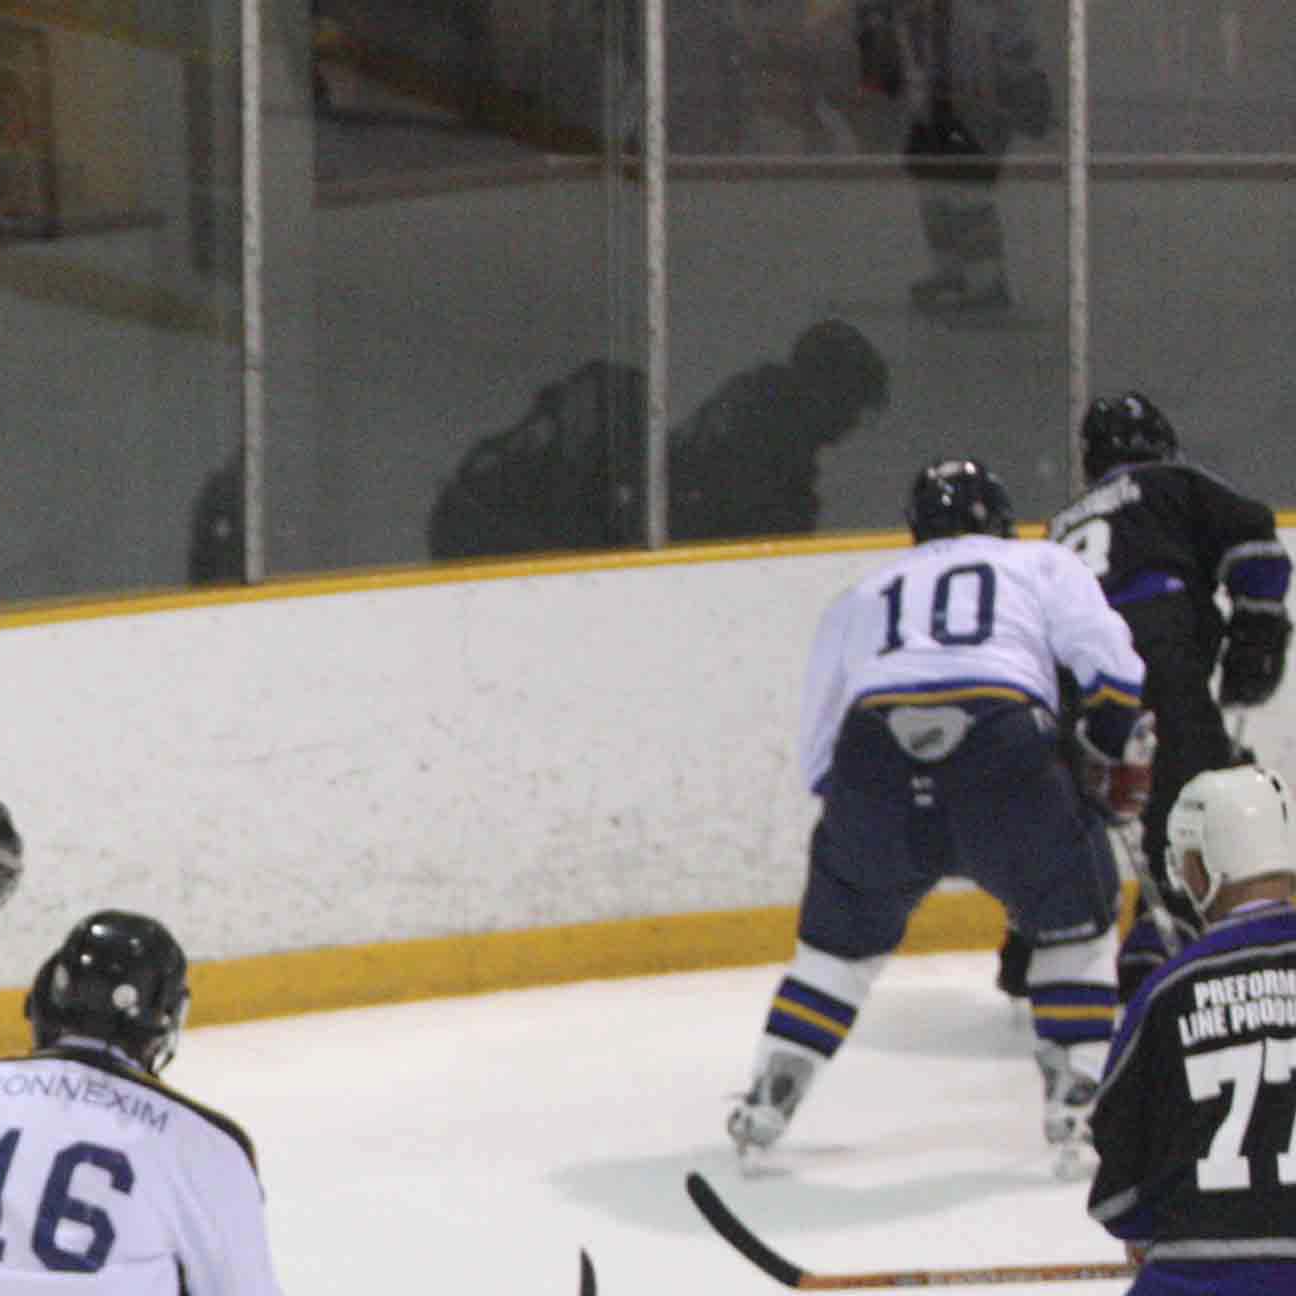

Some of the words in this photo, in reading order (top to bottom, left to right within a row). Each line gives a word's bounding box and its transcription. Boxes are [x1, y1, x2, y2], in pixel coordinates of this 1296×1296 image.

[877, 563, 997, 656] 10
[1177, 1009, 1229, 1048] LINE
[1183, 1036, 1296, 1191] 77
